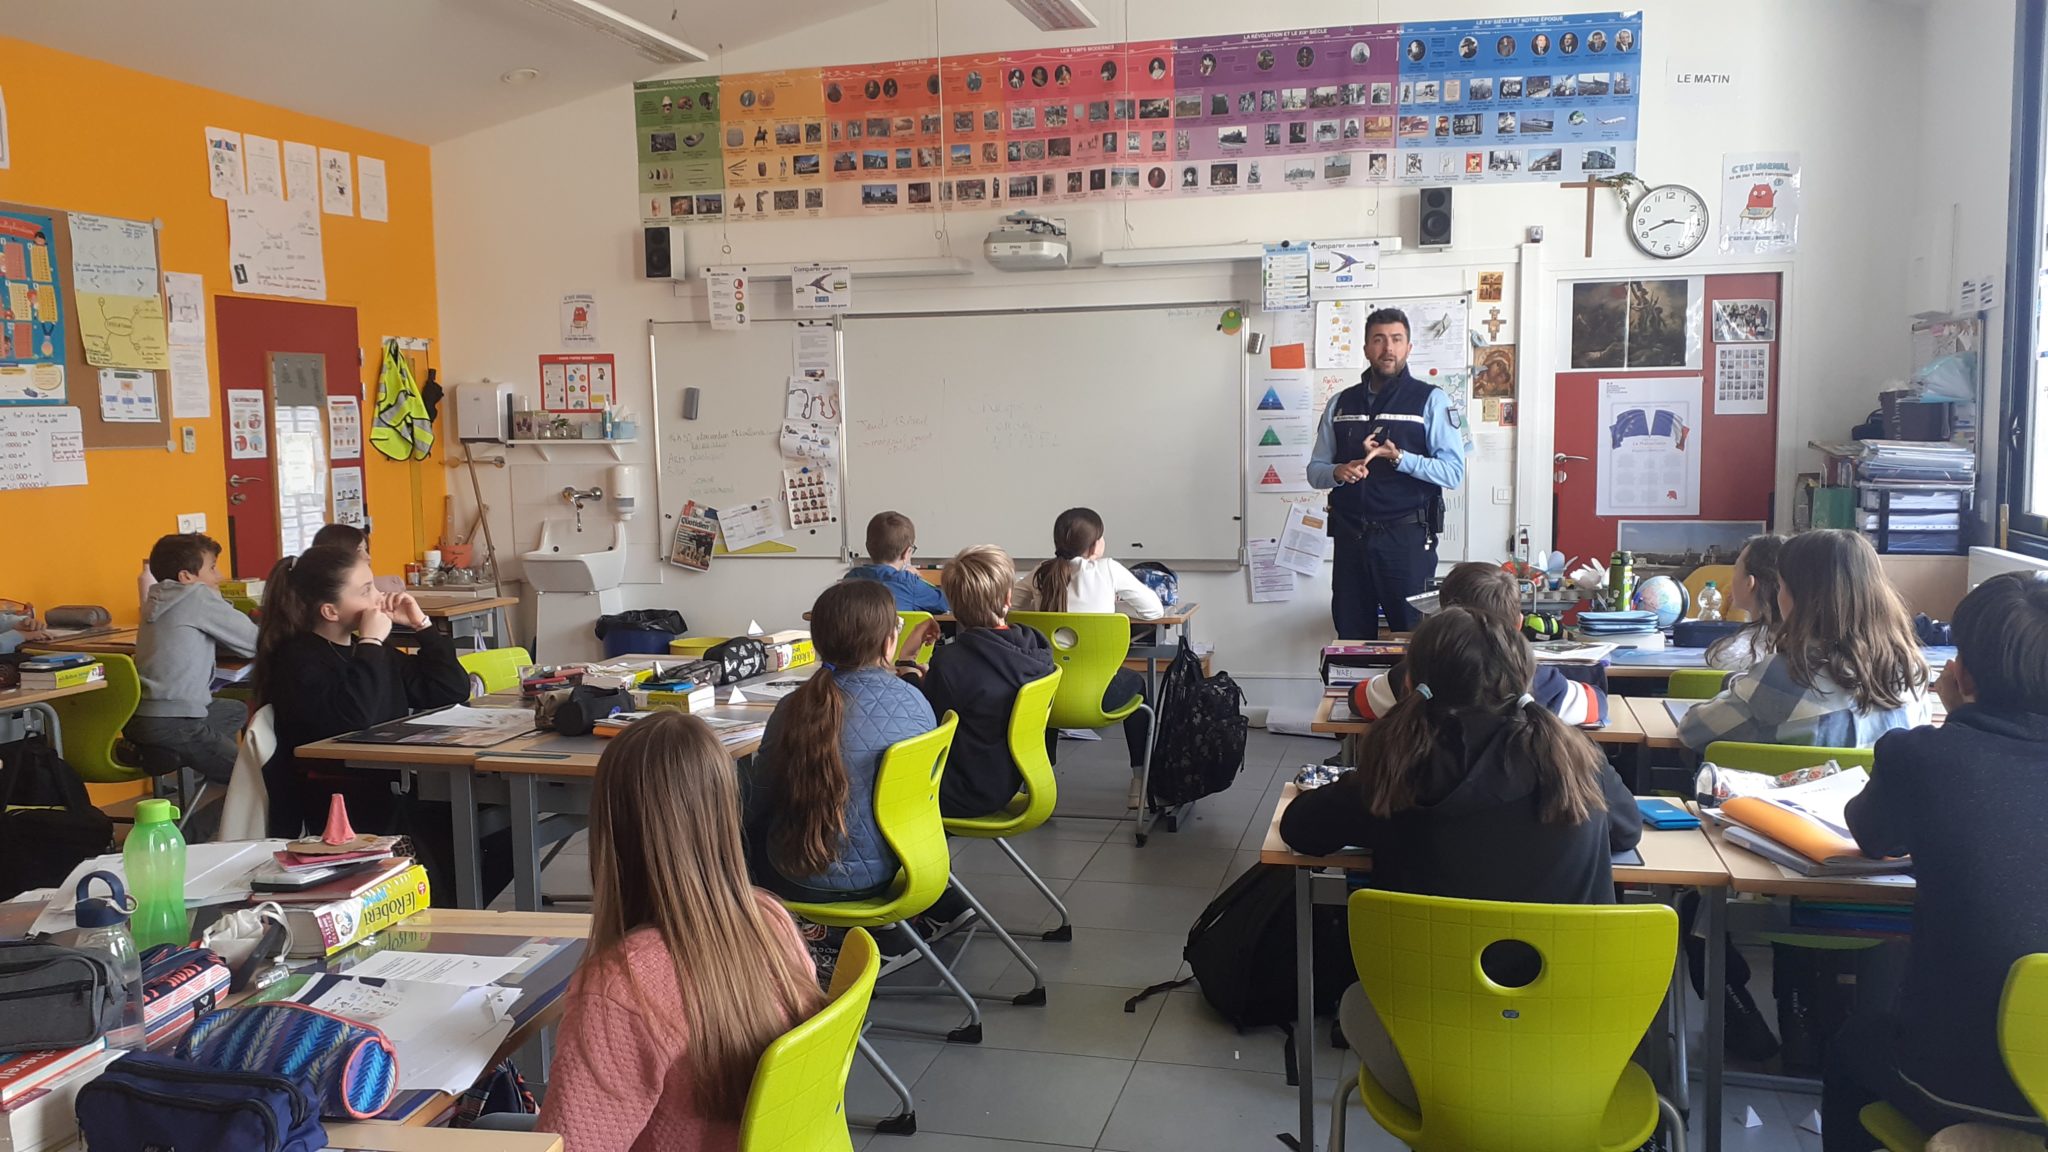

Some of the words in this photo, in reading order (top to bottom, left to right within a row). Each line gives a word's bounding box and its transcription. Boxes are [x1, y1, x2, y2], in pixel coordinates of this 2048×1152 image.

[1677, 74, 1691, 83] LE
[1694, 74, 1730, 84] MATIN
[1732, 164, 1754, 173] C'EST
[681, 518, 710, 529] Quotidien
